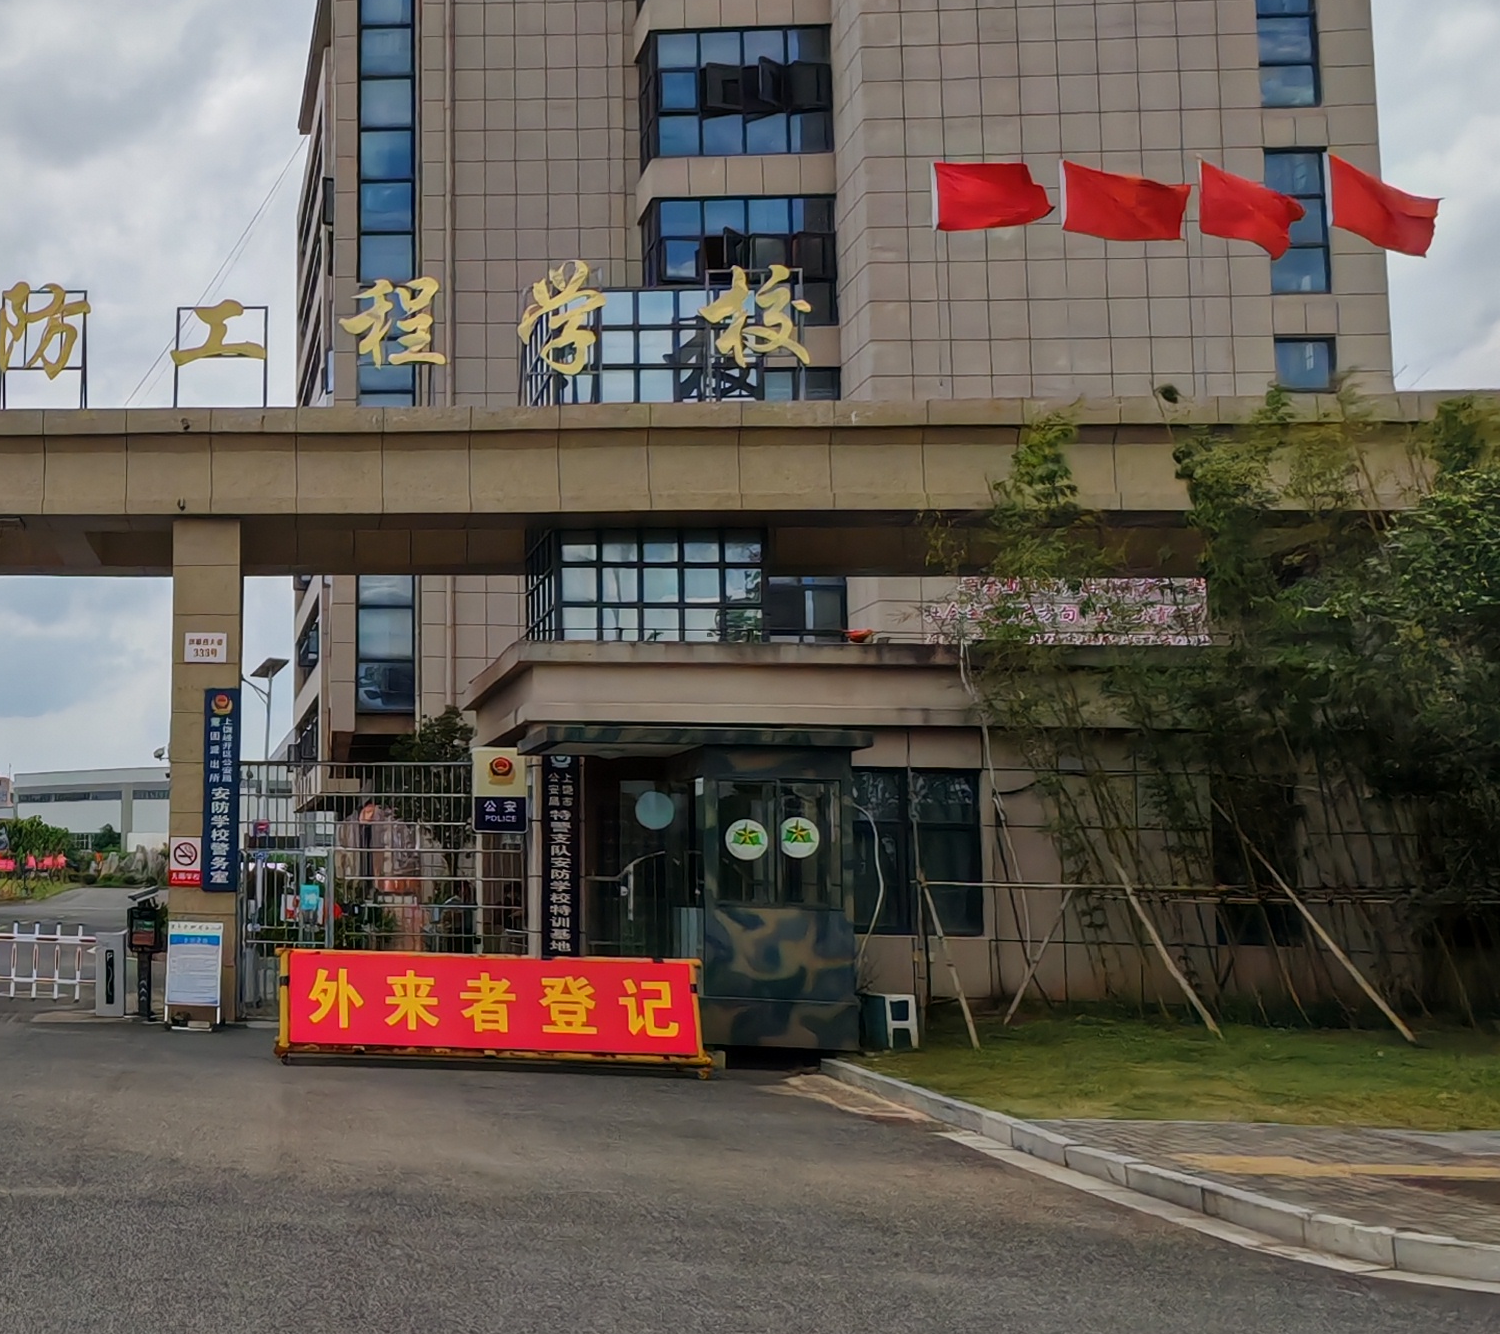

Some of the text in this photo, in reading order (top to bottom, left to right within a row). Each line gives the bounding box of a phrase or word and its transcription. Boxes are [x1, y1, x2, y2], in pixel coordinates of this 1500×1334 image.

[210, 786, 230, 884] 安防学校警务室
[483, 799, 518, 813] 公安
[484, 814, 517, 823] POLICE
[549, 809, 572, 952] 特警支队安防学校特训基地
[308, 968, 680, 1038] 外来者登记
